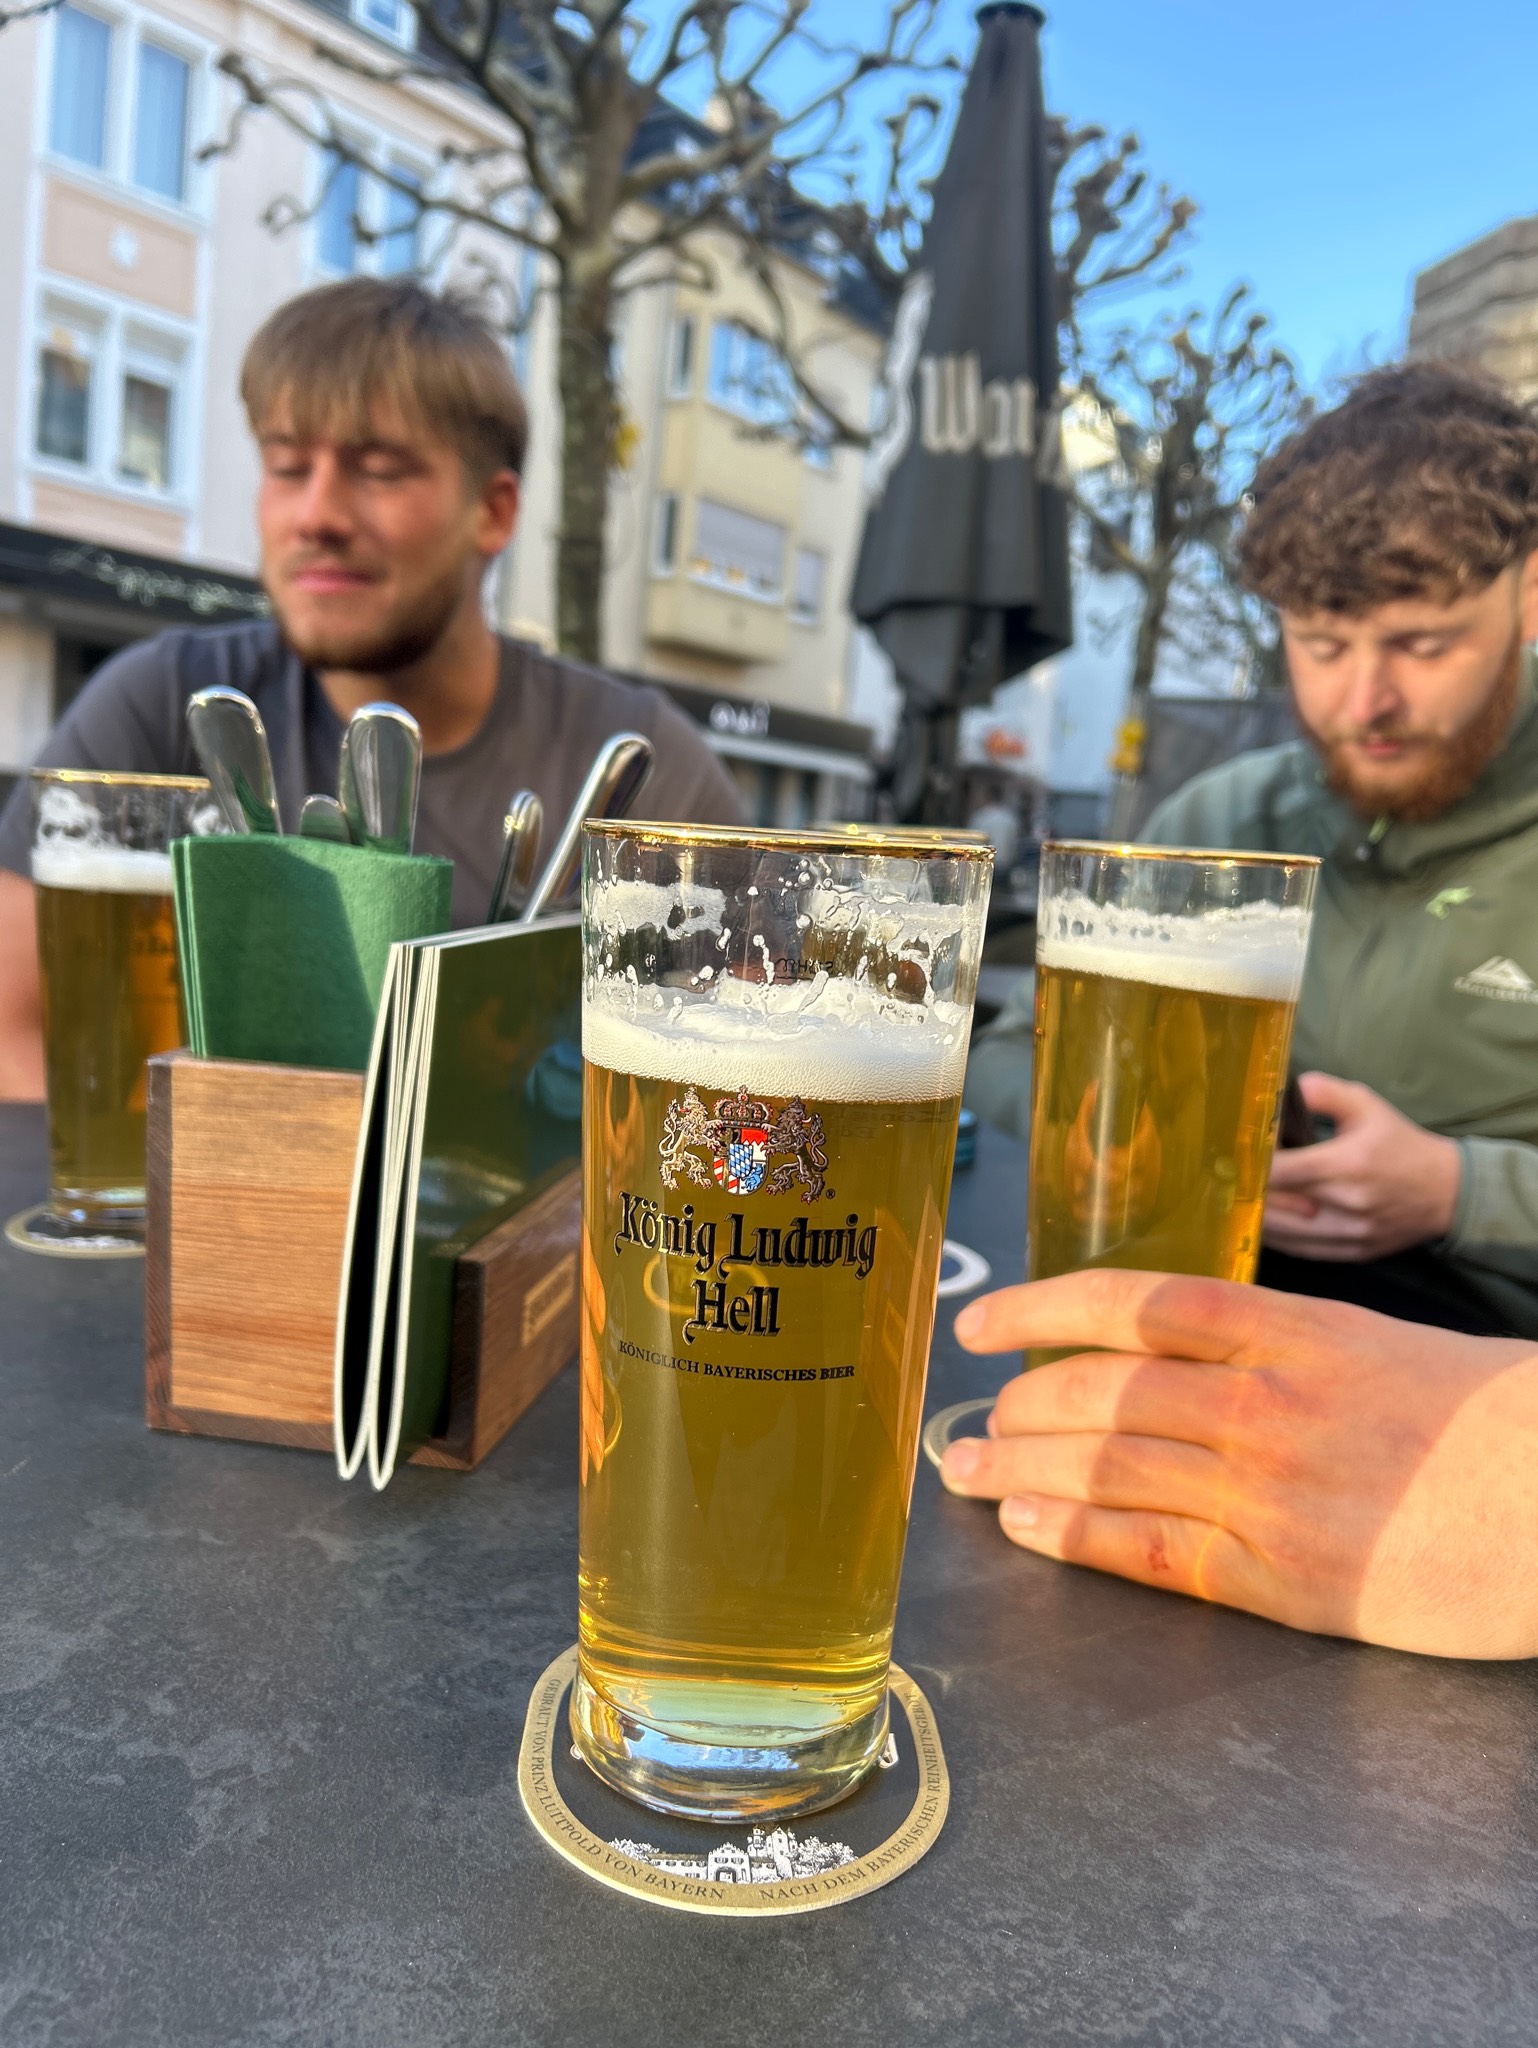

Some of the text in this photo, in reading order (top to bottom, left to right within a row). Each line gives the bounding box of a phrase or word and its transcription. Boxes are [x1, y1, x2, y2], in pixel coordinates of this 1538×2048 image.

[614, 1191, 878, 1281] König Ludwig
[682, 1279, 780, 1346] Hell
[619, 1340, 855, 1382] KÖNIGLICH BAYERISCHES BIER
[531, 1678, 725, 1900] GEBRAUT VON PRINZ LUITPOLD VON BAYERN
[759, 1692, 941, 1901] NACH DEM BAYERISCHEN REINHEITSGEBOT
